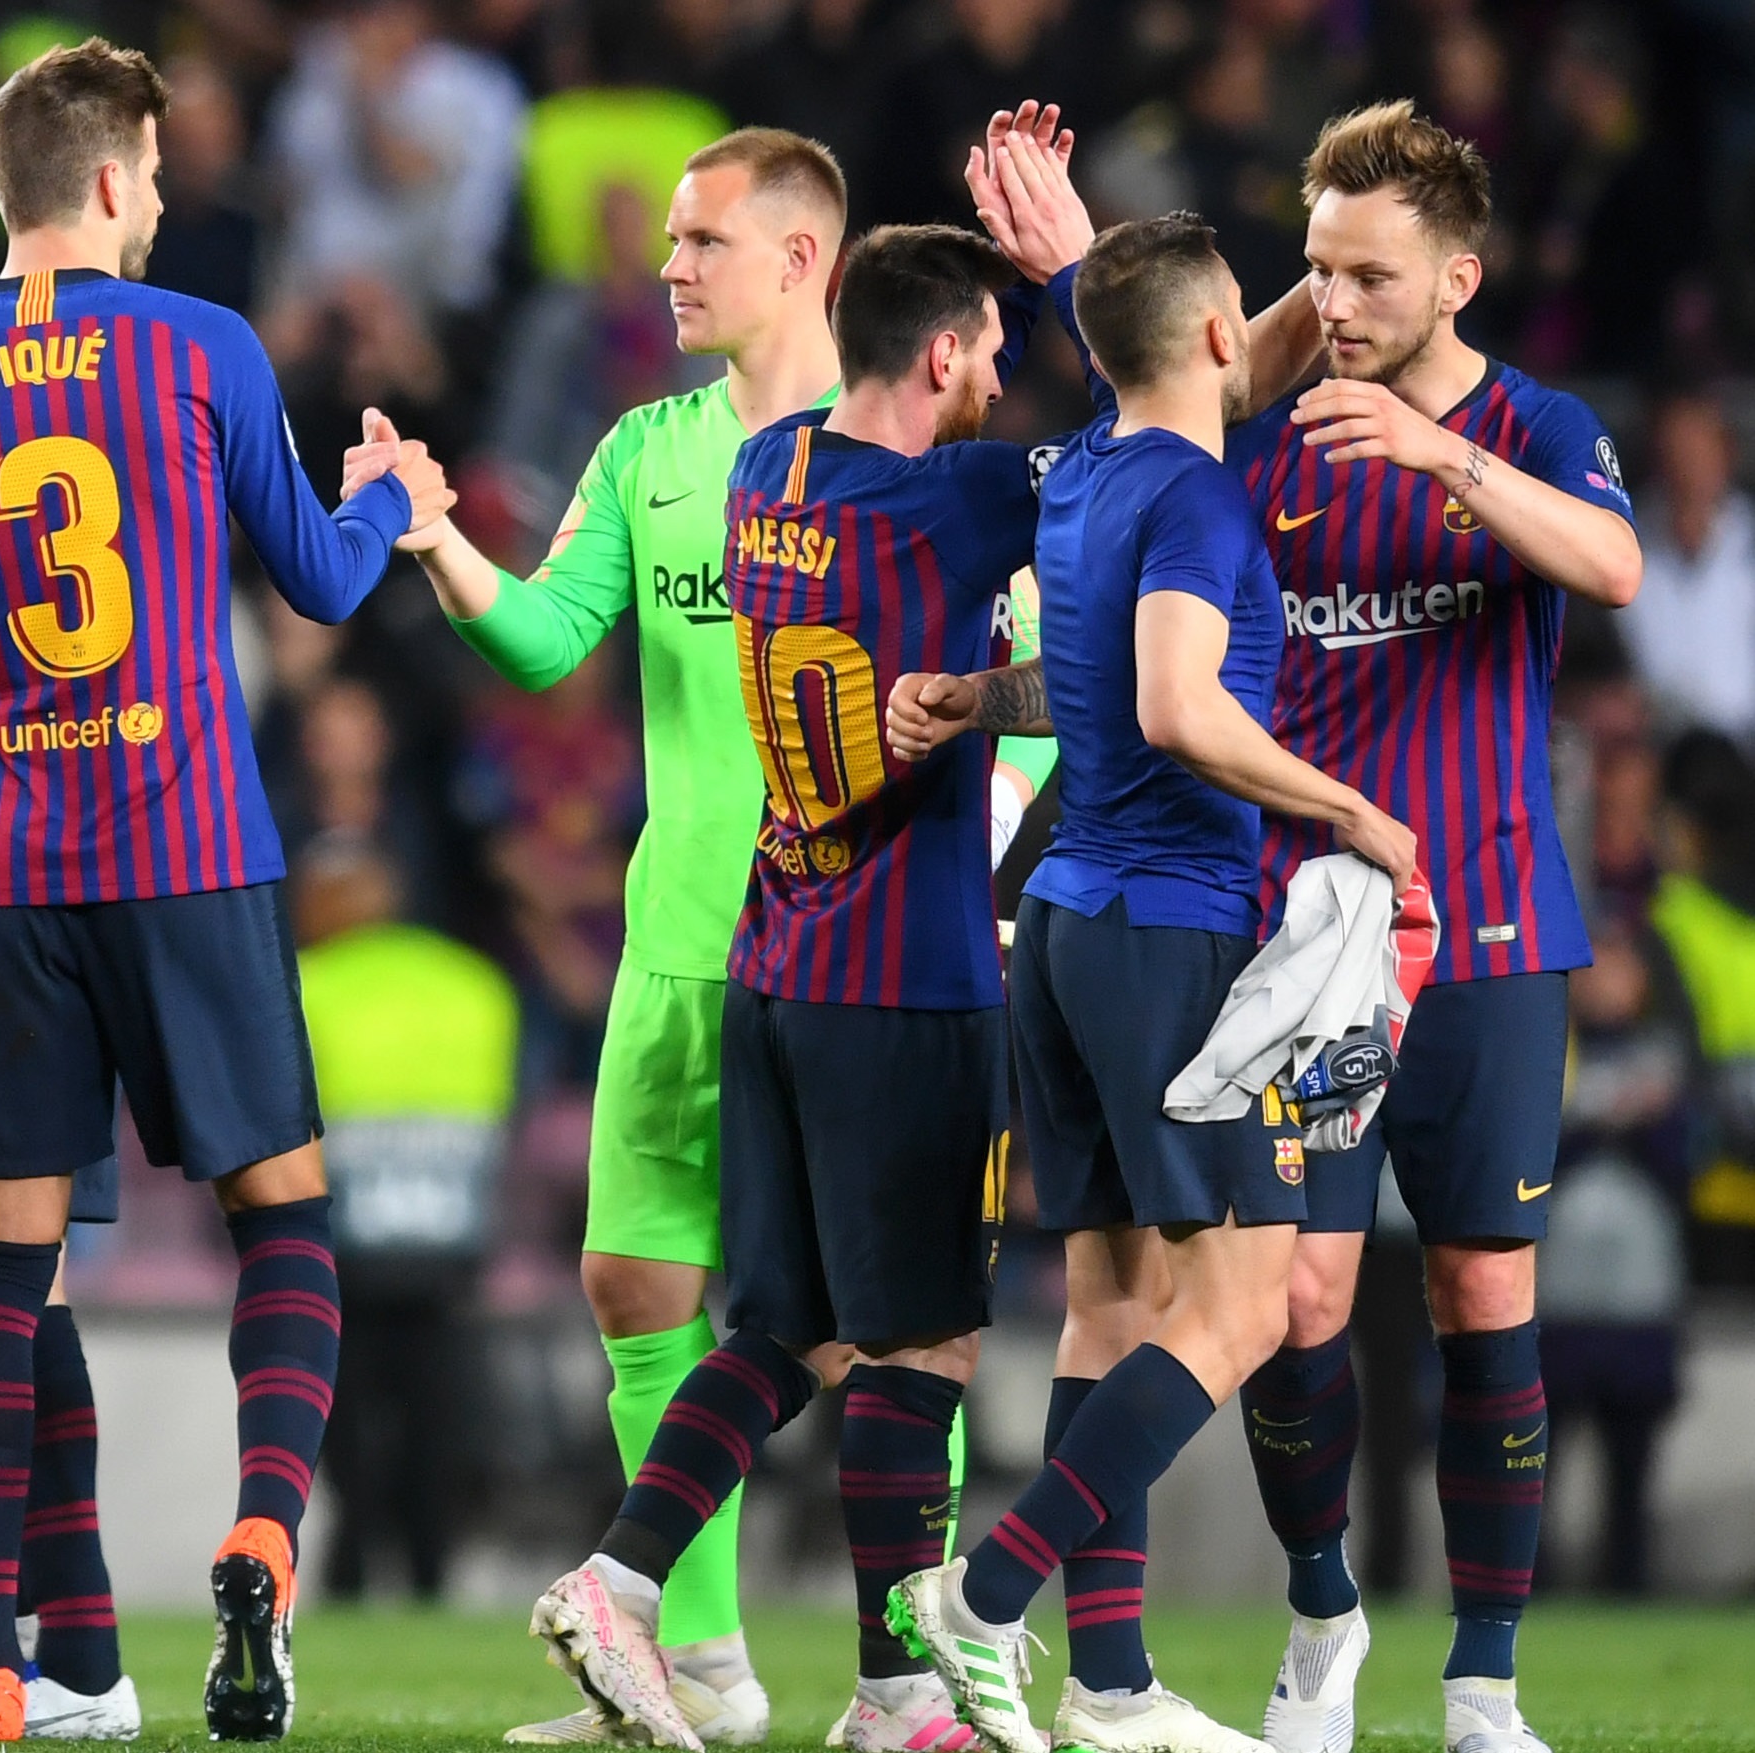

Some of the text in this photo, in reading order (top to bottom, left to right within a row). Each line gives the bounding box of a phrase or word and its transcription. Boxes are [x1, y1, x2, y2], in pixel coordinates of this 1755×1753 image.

[738, 516, 837, 580] MESSI
[1282, 580, 1485, 638] Rakuten
[0, 706, 113, 753] unicef
[734, 611, 886, 831] 10
[1345, 1063, 1363, 1076] 5
